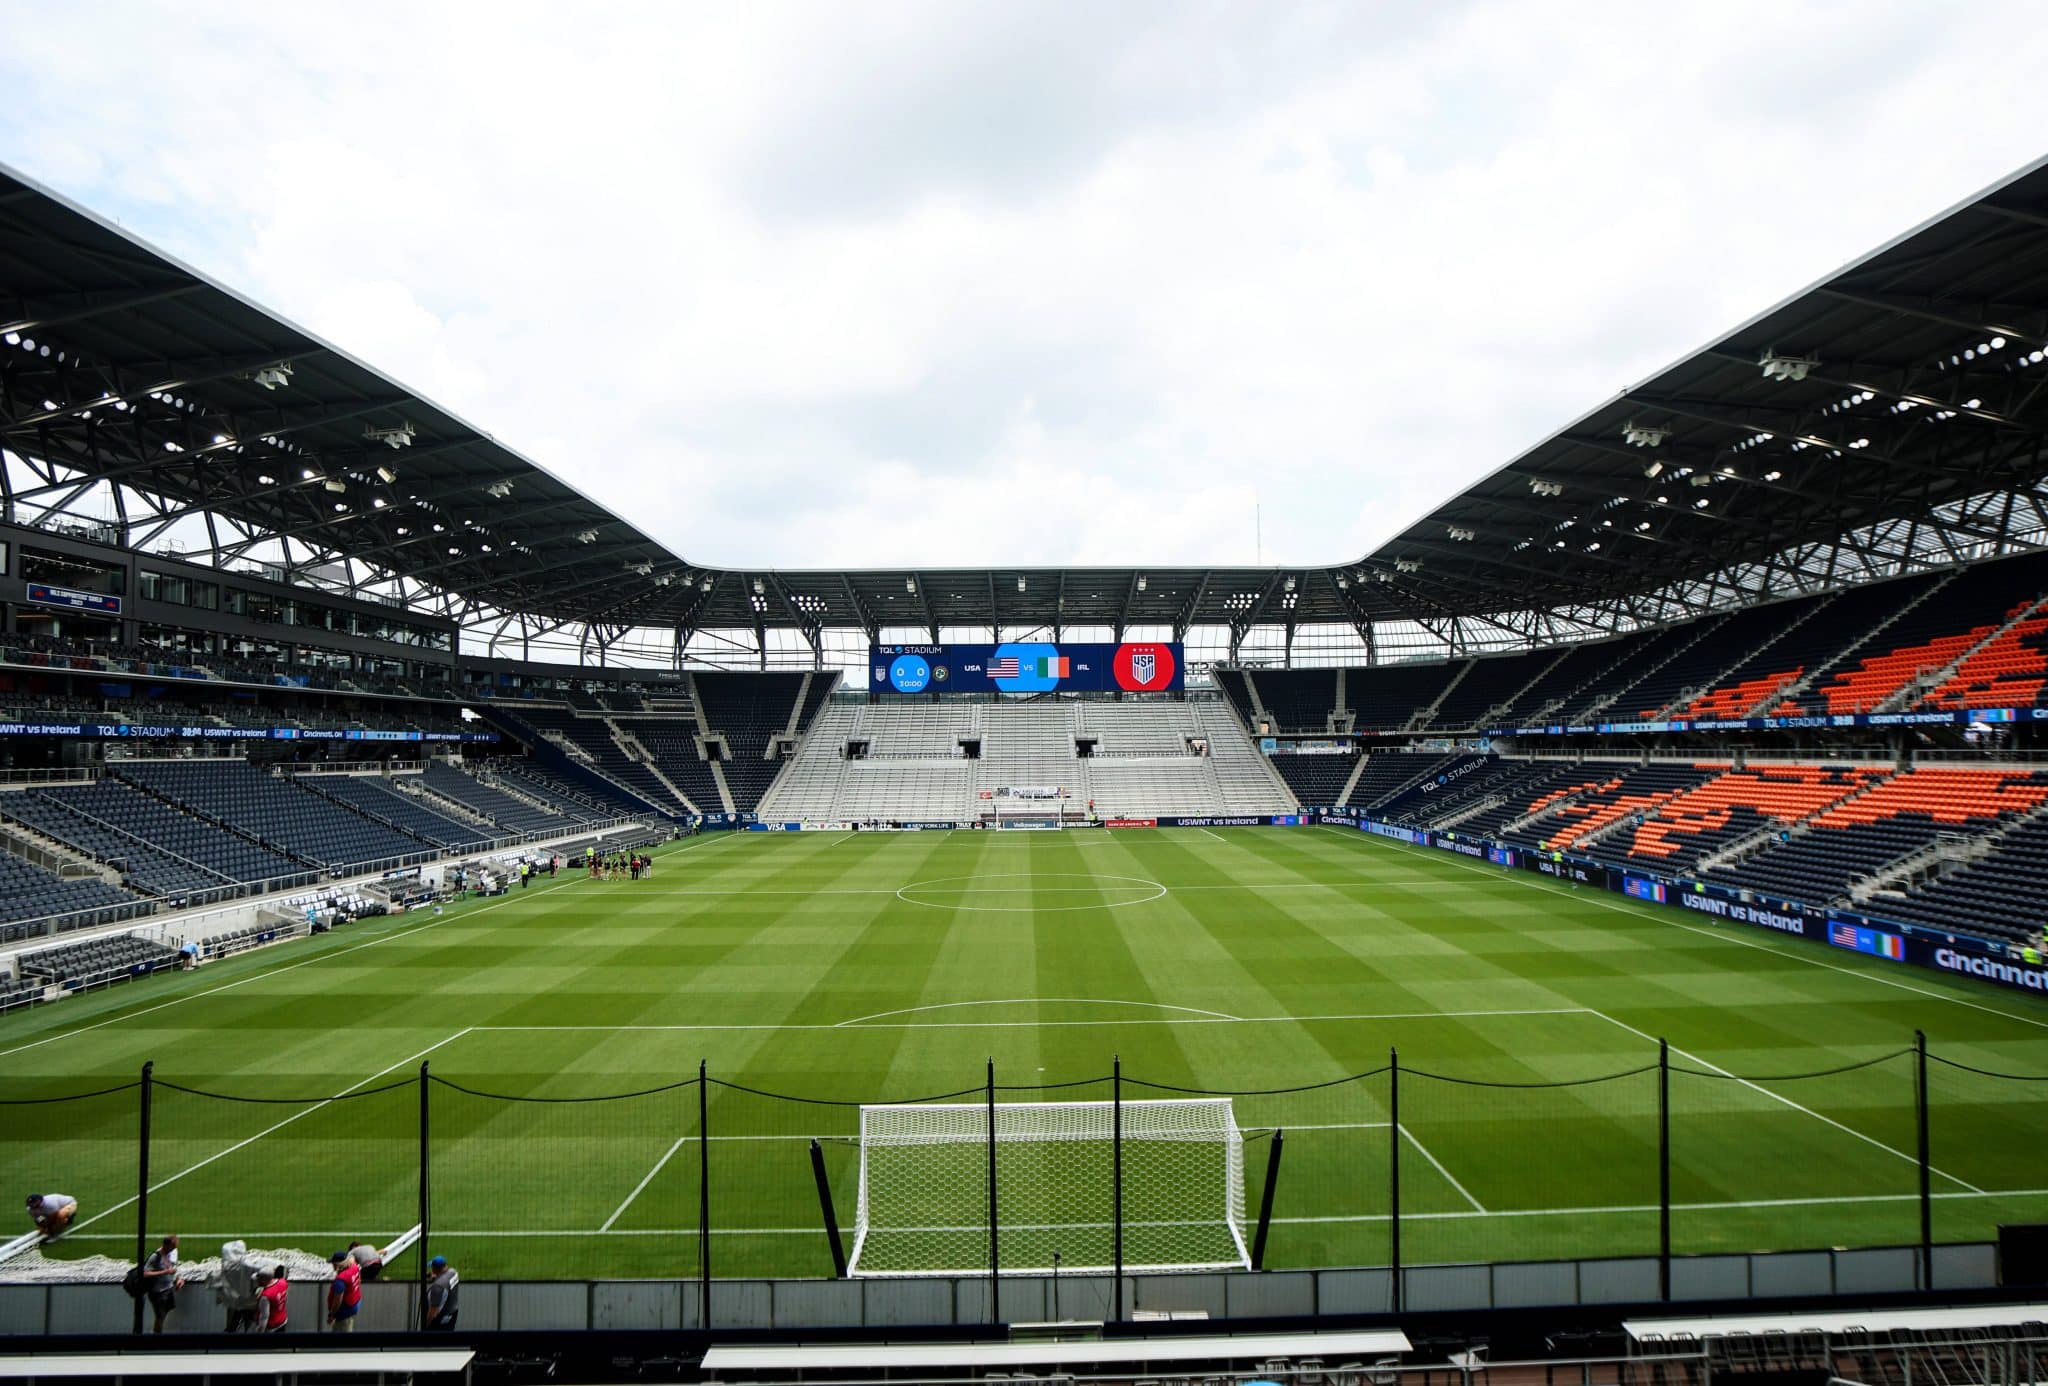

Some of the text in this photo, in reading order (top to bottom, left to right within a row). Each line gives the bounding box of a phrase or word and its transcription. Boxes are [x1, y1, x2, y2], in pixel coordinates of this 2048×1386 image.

[1134, 655, 1154, 667] USA
[896, 668, 925, 677] 0 0
[1764, 718, 1827, 728] TQL STADIUM
[1868, 716, 1902, 724] USWNT
[1916, 713, 1954, 722] Ireland
[42, 726, 80, 734] Ireland
[97, 726, 175, 736] TQL STADIUM
[1420, 756, 1488, 794] TQL STADIUM
[1436, 838, 1455, 849] USWNT
[1462, 844, 1482, 856] Ireland
[1539, 862, 1588, 881] USA IRL
[1683, 893, 1803, 934] USWNT vs Ireland
